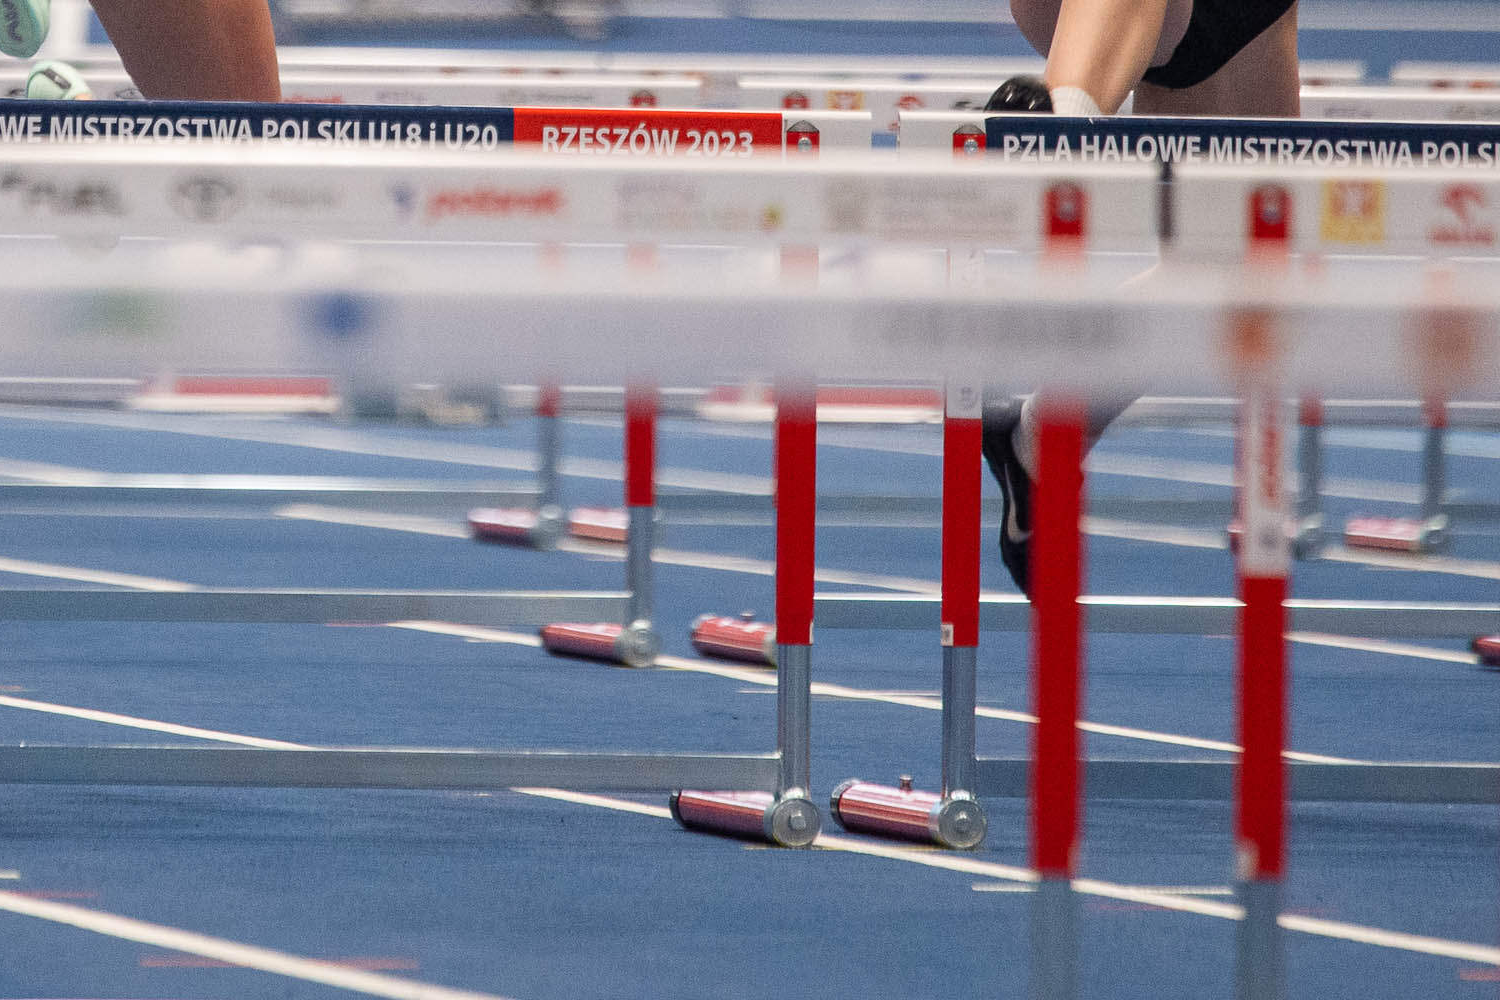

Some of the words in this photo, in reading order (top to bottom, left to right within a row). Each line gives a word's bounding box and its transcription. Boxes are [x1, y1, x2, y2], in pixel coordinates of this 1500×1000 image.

[50, 116, 253, 146] MISTRZOSTWA
[261, 119, 361, 147] POLSKI
[368, 122, 422, 149] U18
[428, 122, 437, 150] i
[443, 123, 499, 152] U20
[542, 121, 680, 155] RZESZÓW
[685, 130, 755, 158] 2023
[1003, 134, 1073, 163] PZLA
[1080, 135, 1202, 164] HALOWE
[1208, 136, 1415, 168] MISTRZOSTWA
[1421, 140, 1500, 169] POLS
